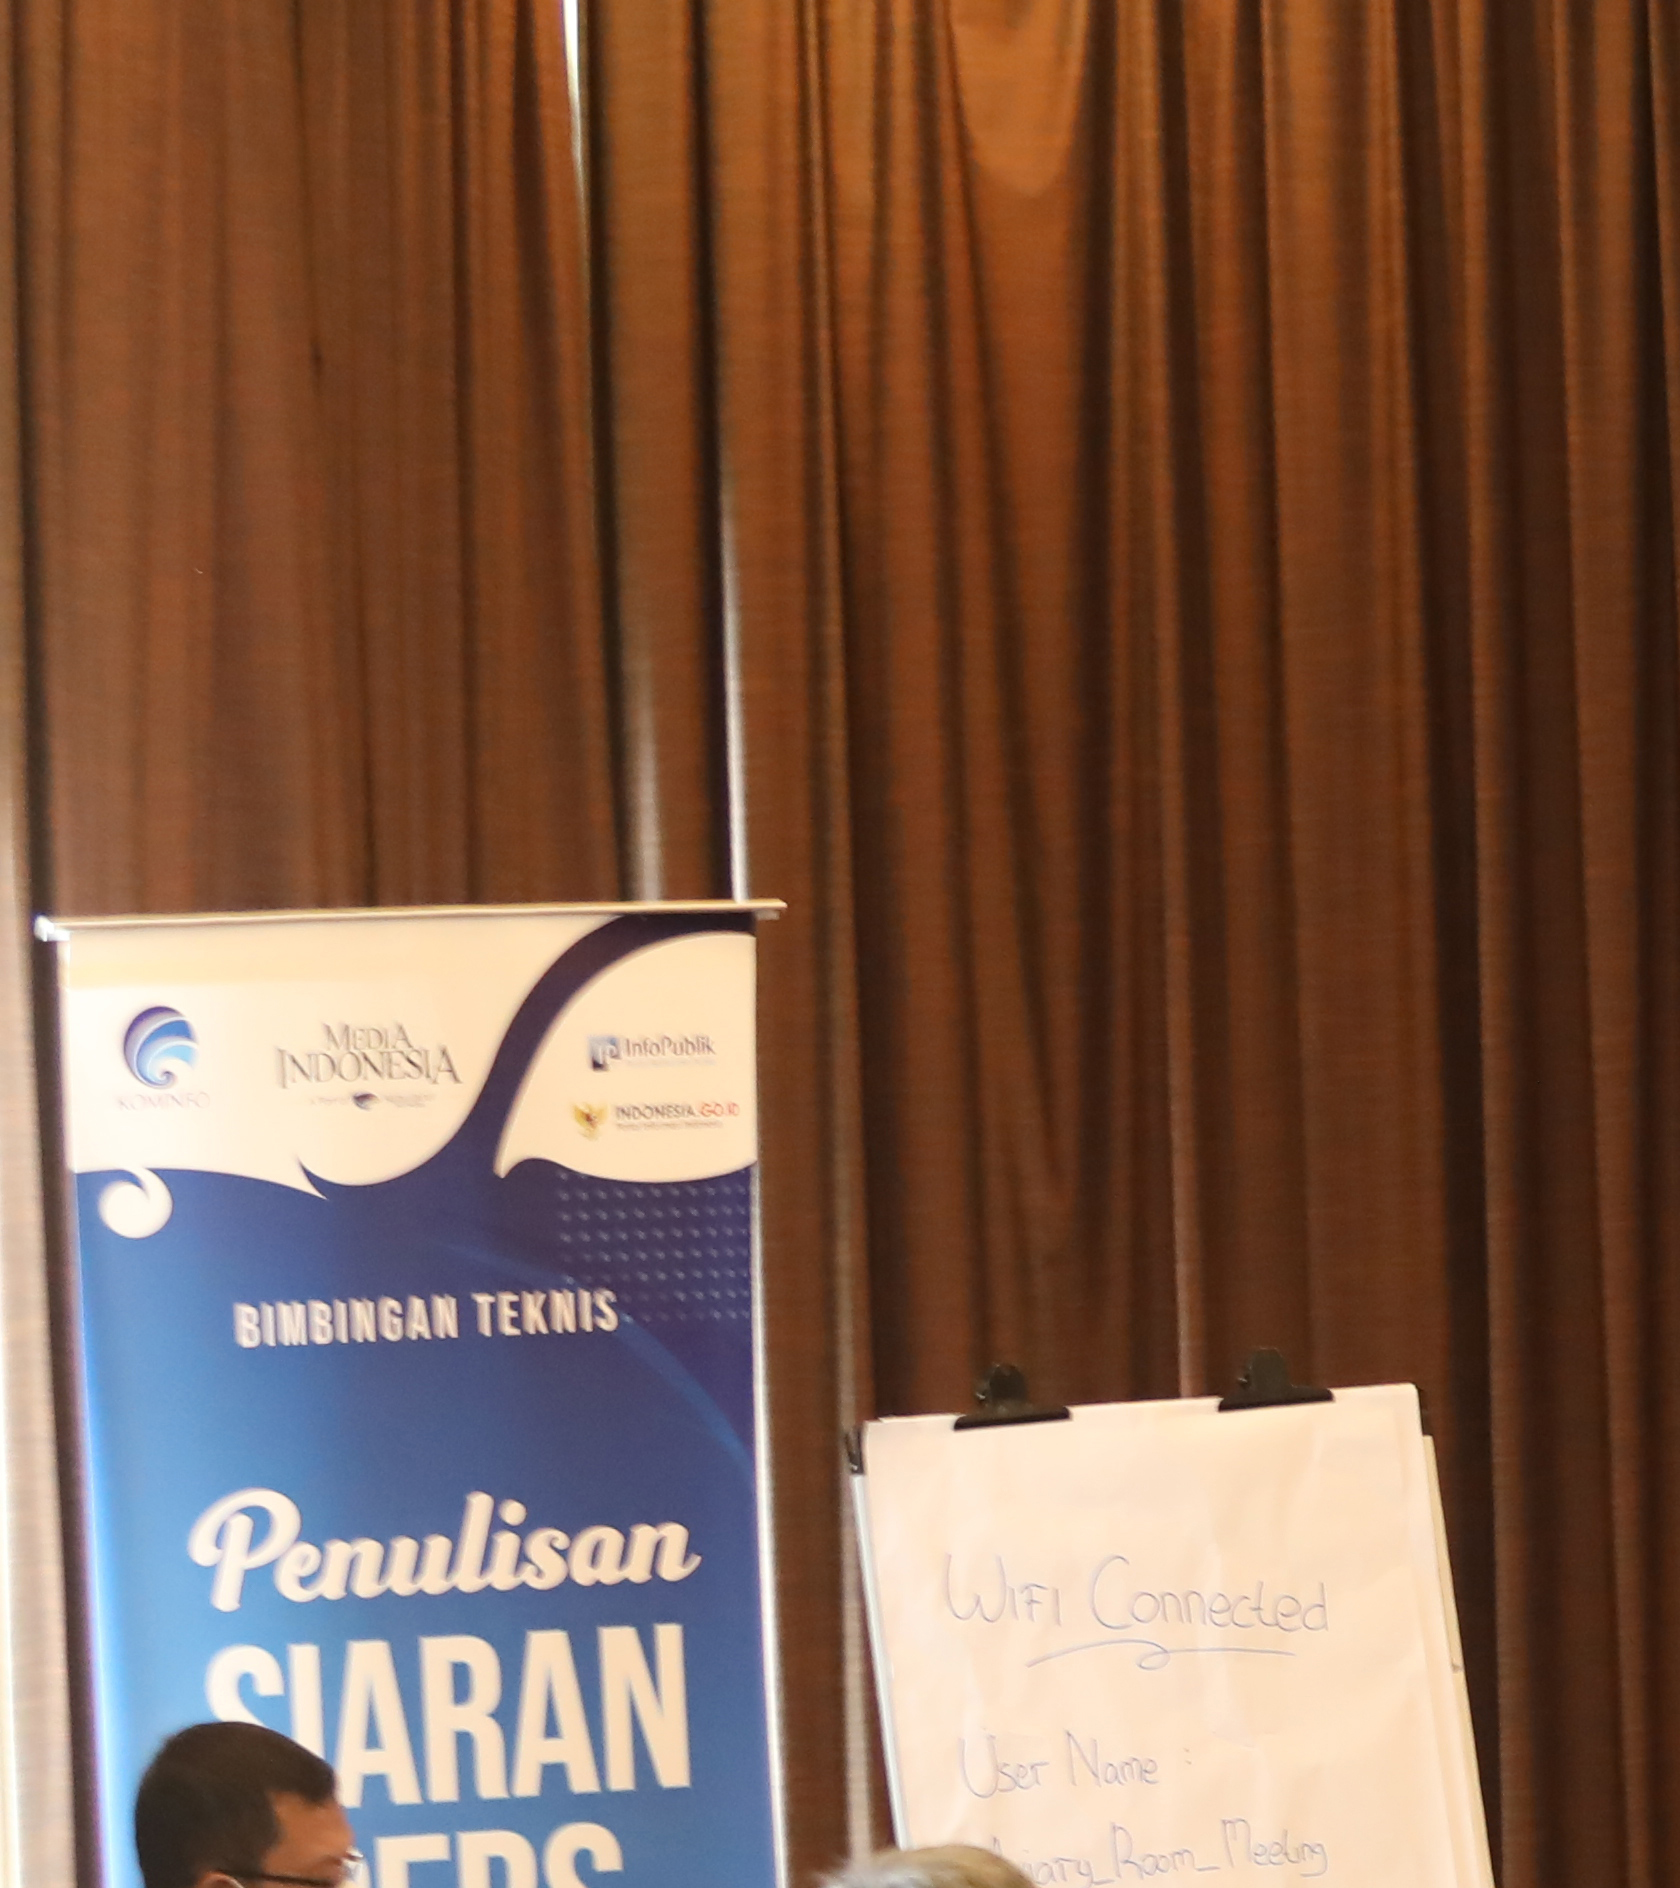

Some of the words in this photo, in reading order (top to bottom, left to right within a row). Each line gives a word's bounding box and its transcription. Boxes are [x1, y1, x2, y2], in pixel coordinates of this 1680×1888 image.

[274, 1044, 463, 1090] INDONESIA
[322, 1022, 414, 1051] MEDIA
[625, 1035, 717, 1058] InfoPublik
[233, 1297, 459, 1349] BIMBINGAN
[471, 1288, 619, 1337] TEKNIS
[188, 1487, 702, 1613] Penulisan
[1089, 1554, 1330, 1632] Connected
[958, 1734, 1049, 1799] User
[1064, 1729, 1159, 1788] Name
